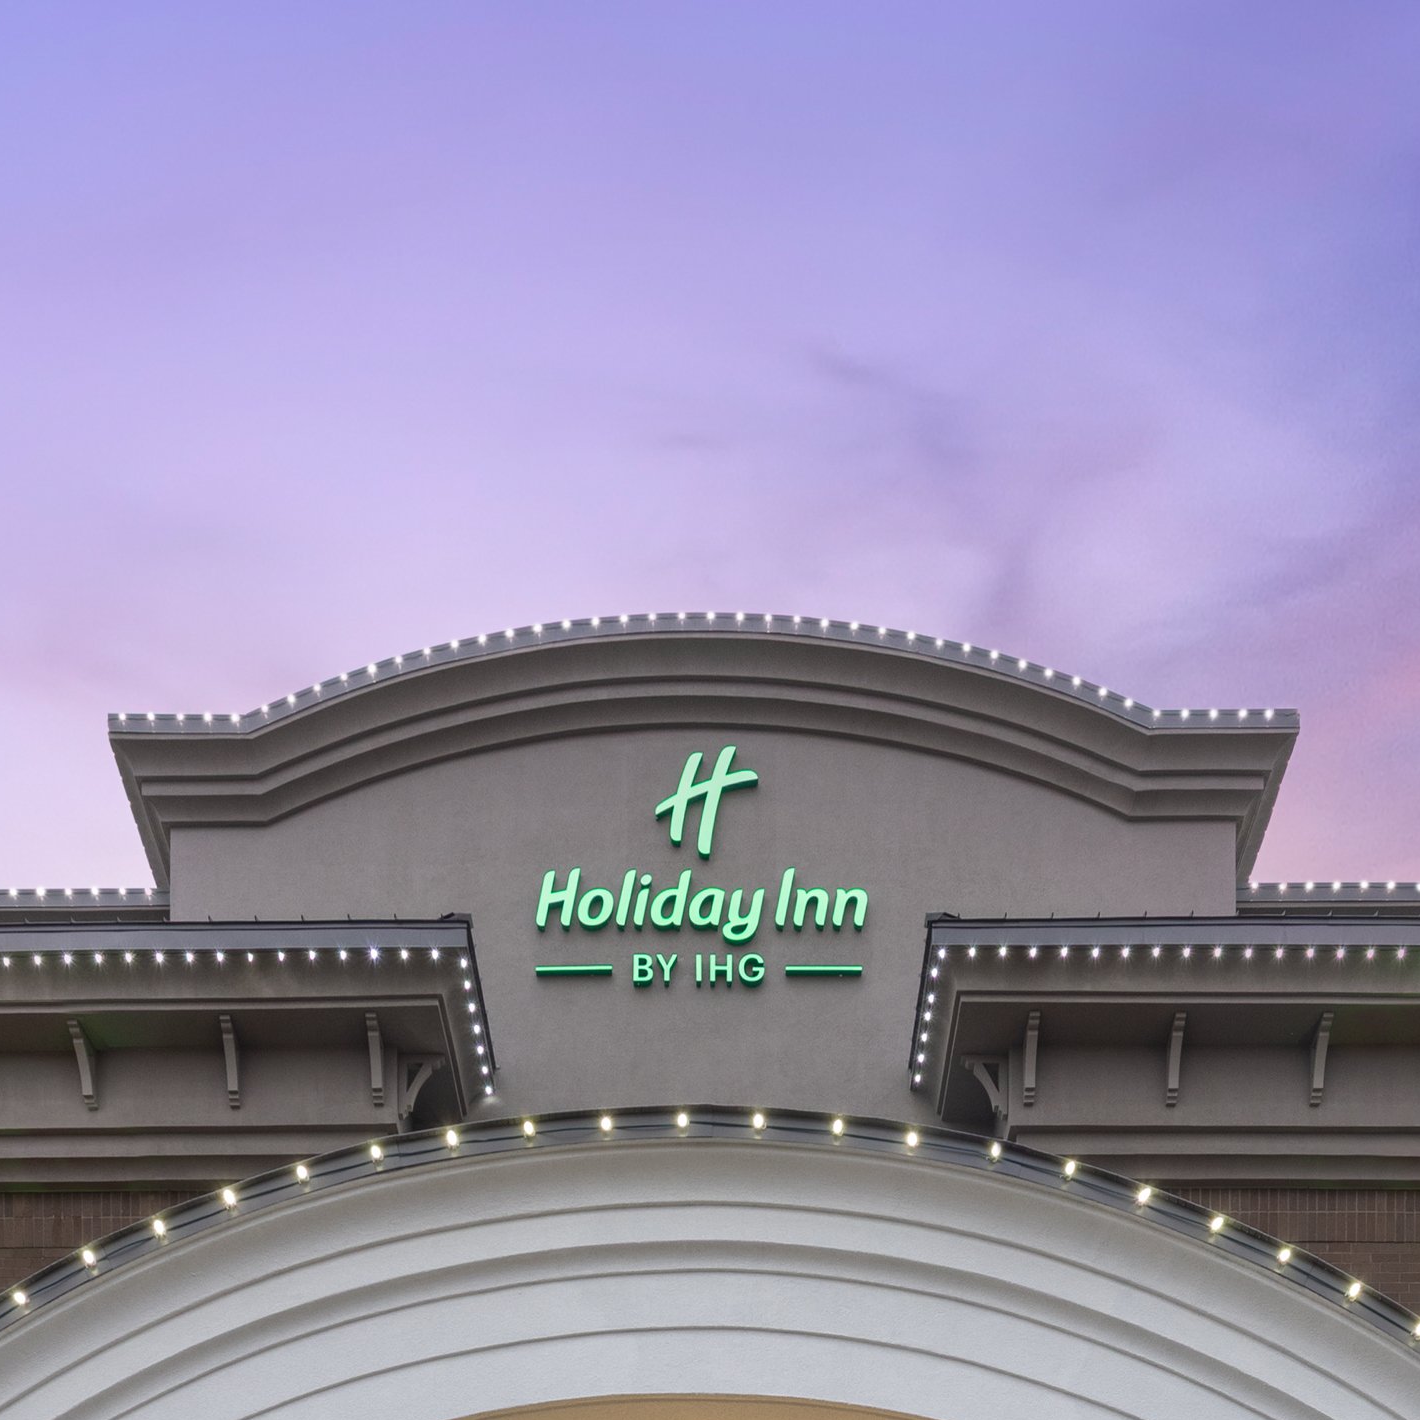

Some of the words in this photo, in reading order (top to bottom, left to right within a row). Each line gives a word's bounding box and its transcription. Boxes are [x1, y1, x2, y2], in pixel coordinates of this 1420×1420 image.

[655, 745, 759, 859] H
[535, 867, 765, 946] Holiday
[775, 867, 869, 932] Inn
[632, 953, 678, 987] BY
[695, 953, 766, 988] IHG
